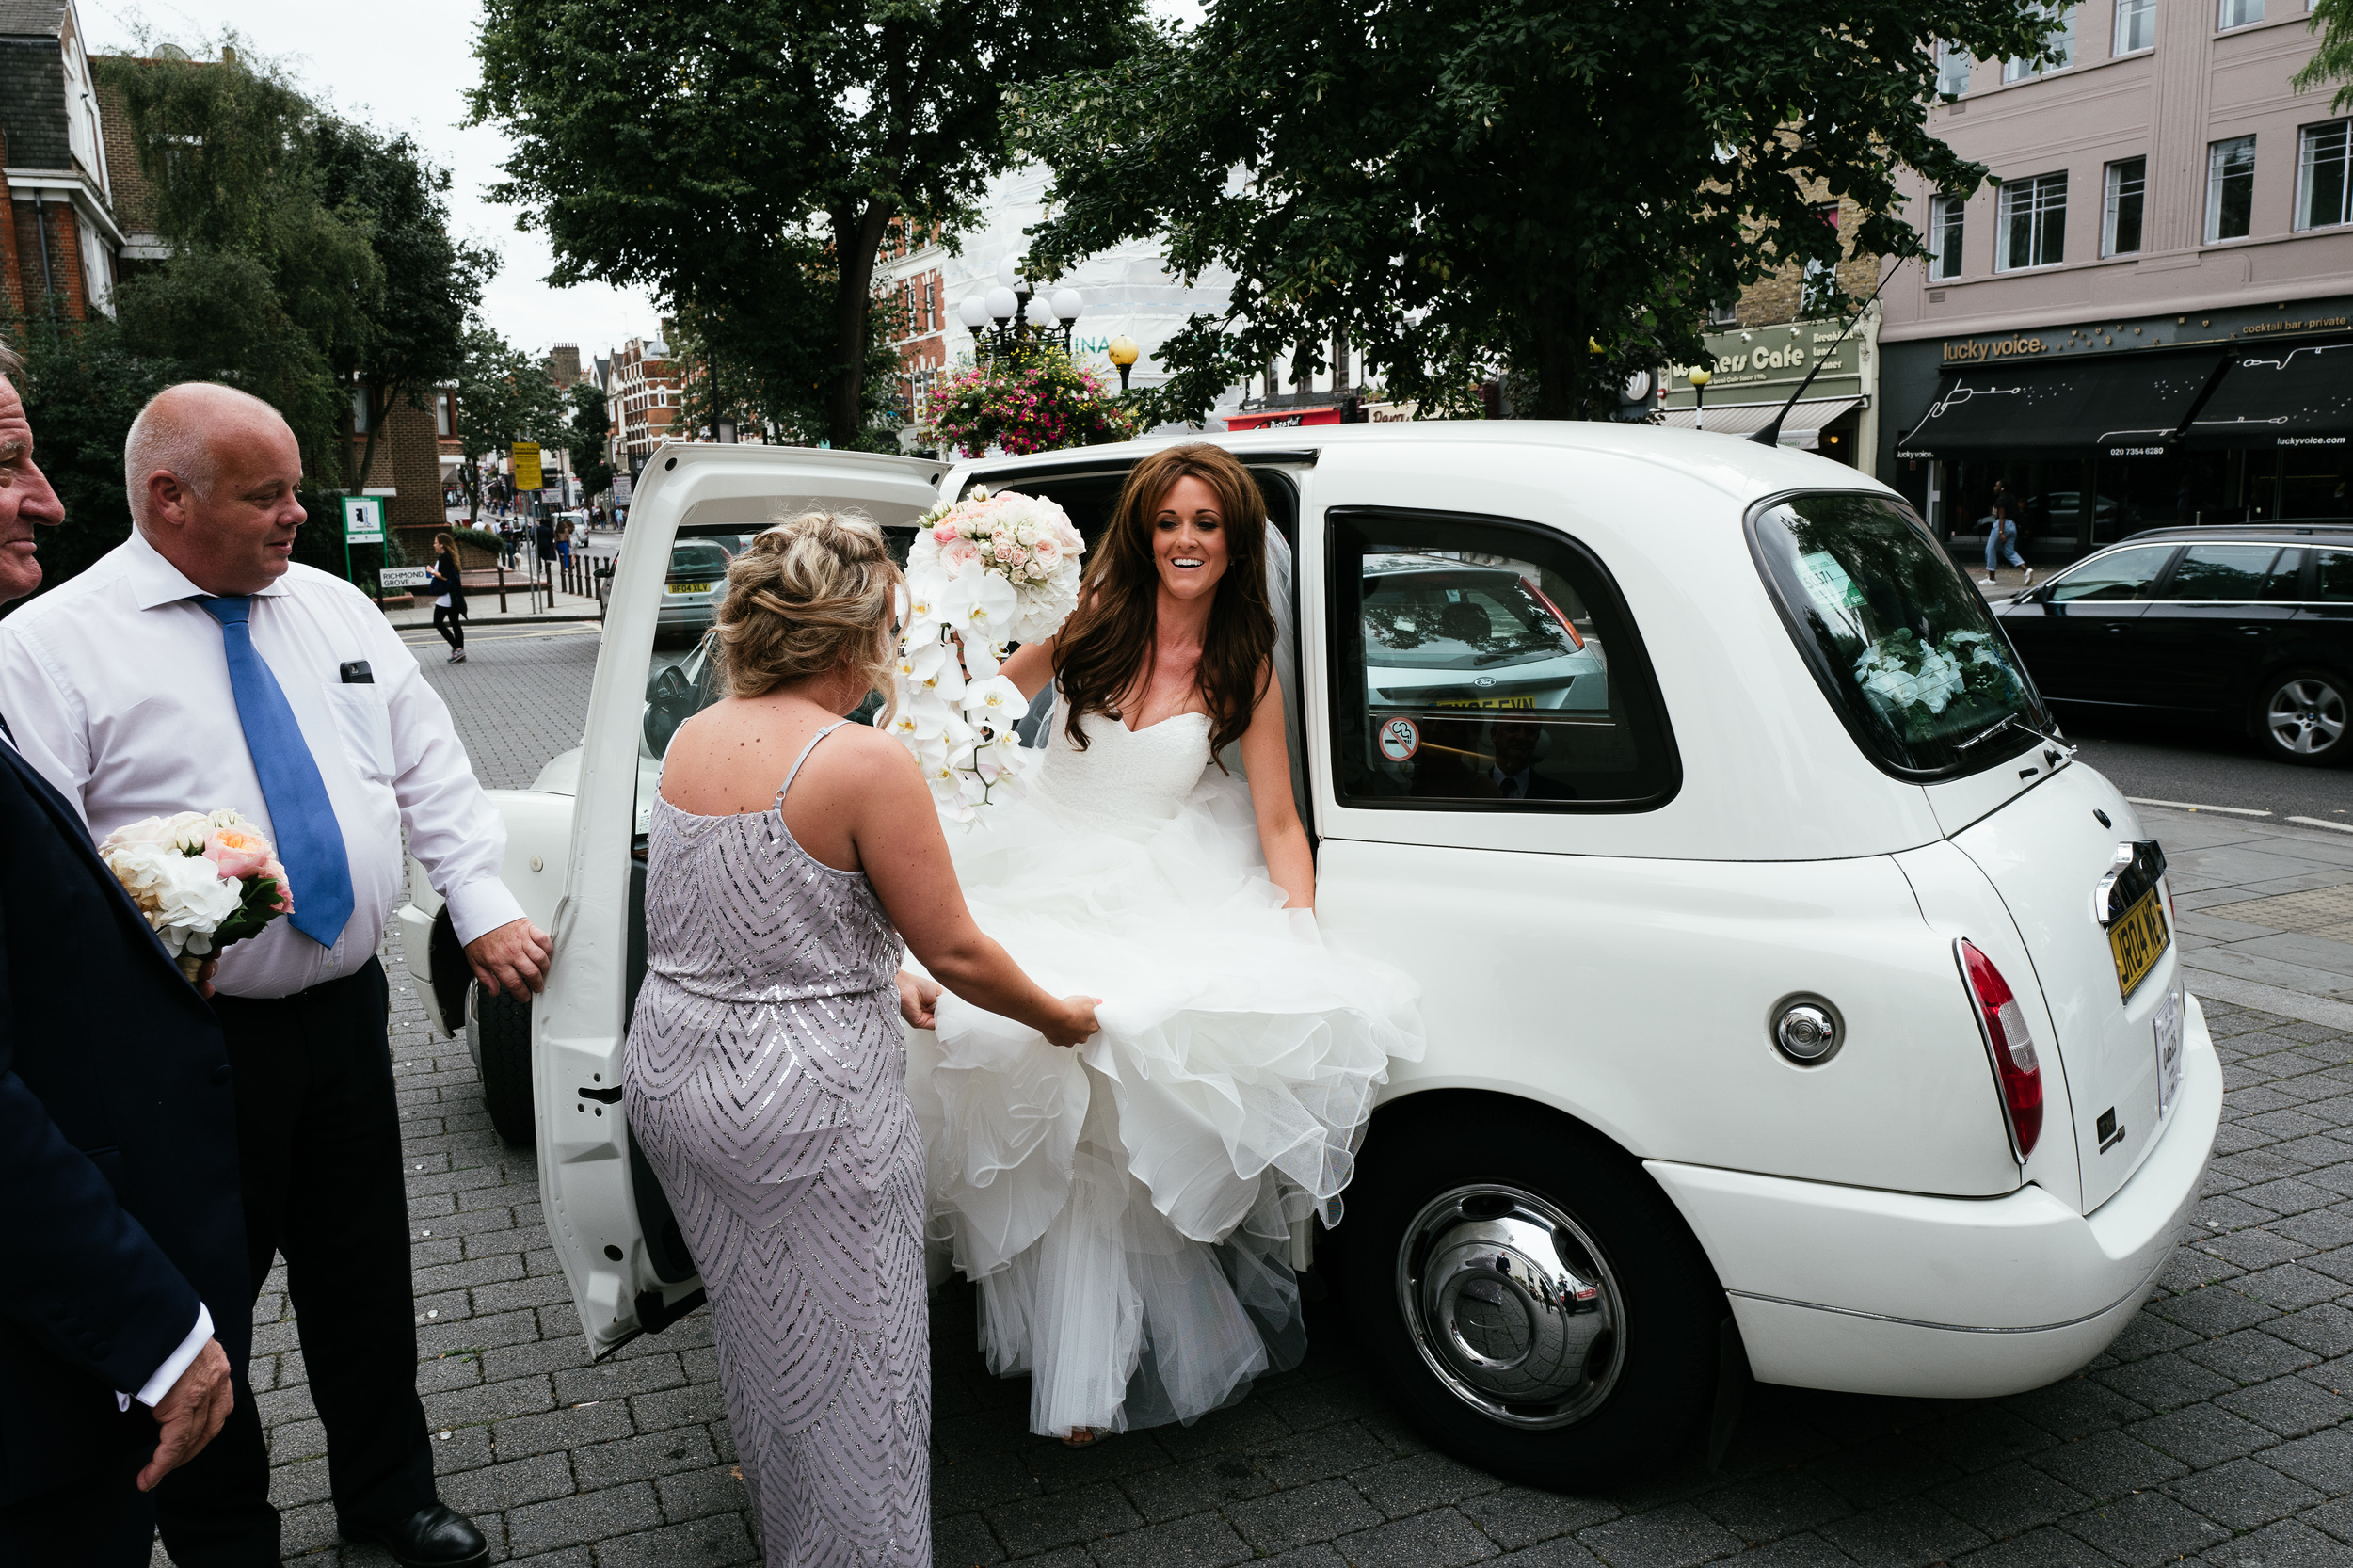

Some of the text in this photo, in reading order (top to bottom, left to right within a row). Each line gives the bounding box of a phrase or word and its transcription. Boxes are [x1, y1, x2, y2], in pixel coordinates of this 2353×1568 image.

[2243, 316, 2346, 334] cocktail bar private
[1944, 333, 2041, 362] lucky voice
[1752, 344, 1805, 370] Cafe
[2277, 436, 2346, 446] luckyvoice.com
[1897, 450, 1914, 459] lucky
[2125, 447, 2144, 456] 7354
[2144, 446, 2164, 456] 6280
[382, 570, 424, 580] RICHMOND
[383, 578, 410, 587] GROVE
[671, 584, 692, 593] BF04
[2117, 913, 2150, 985] JR04
